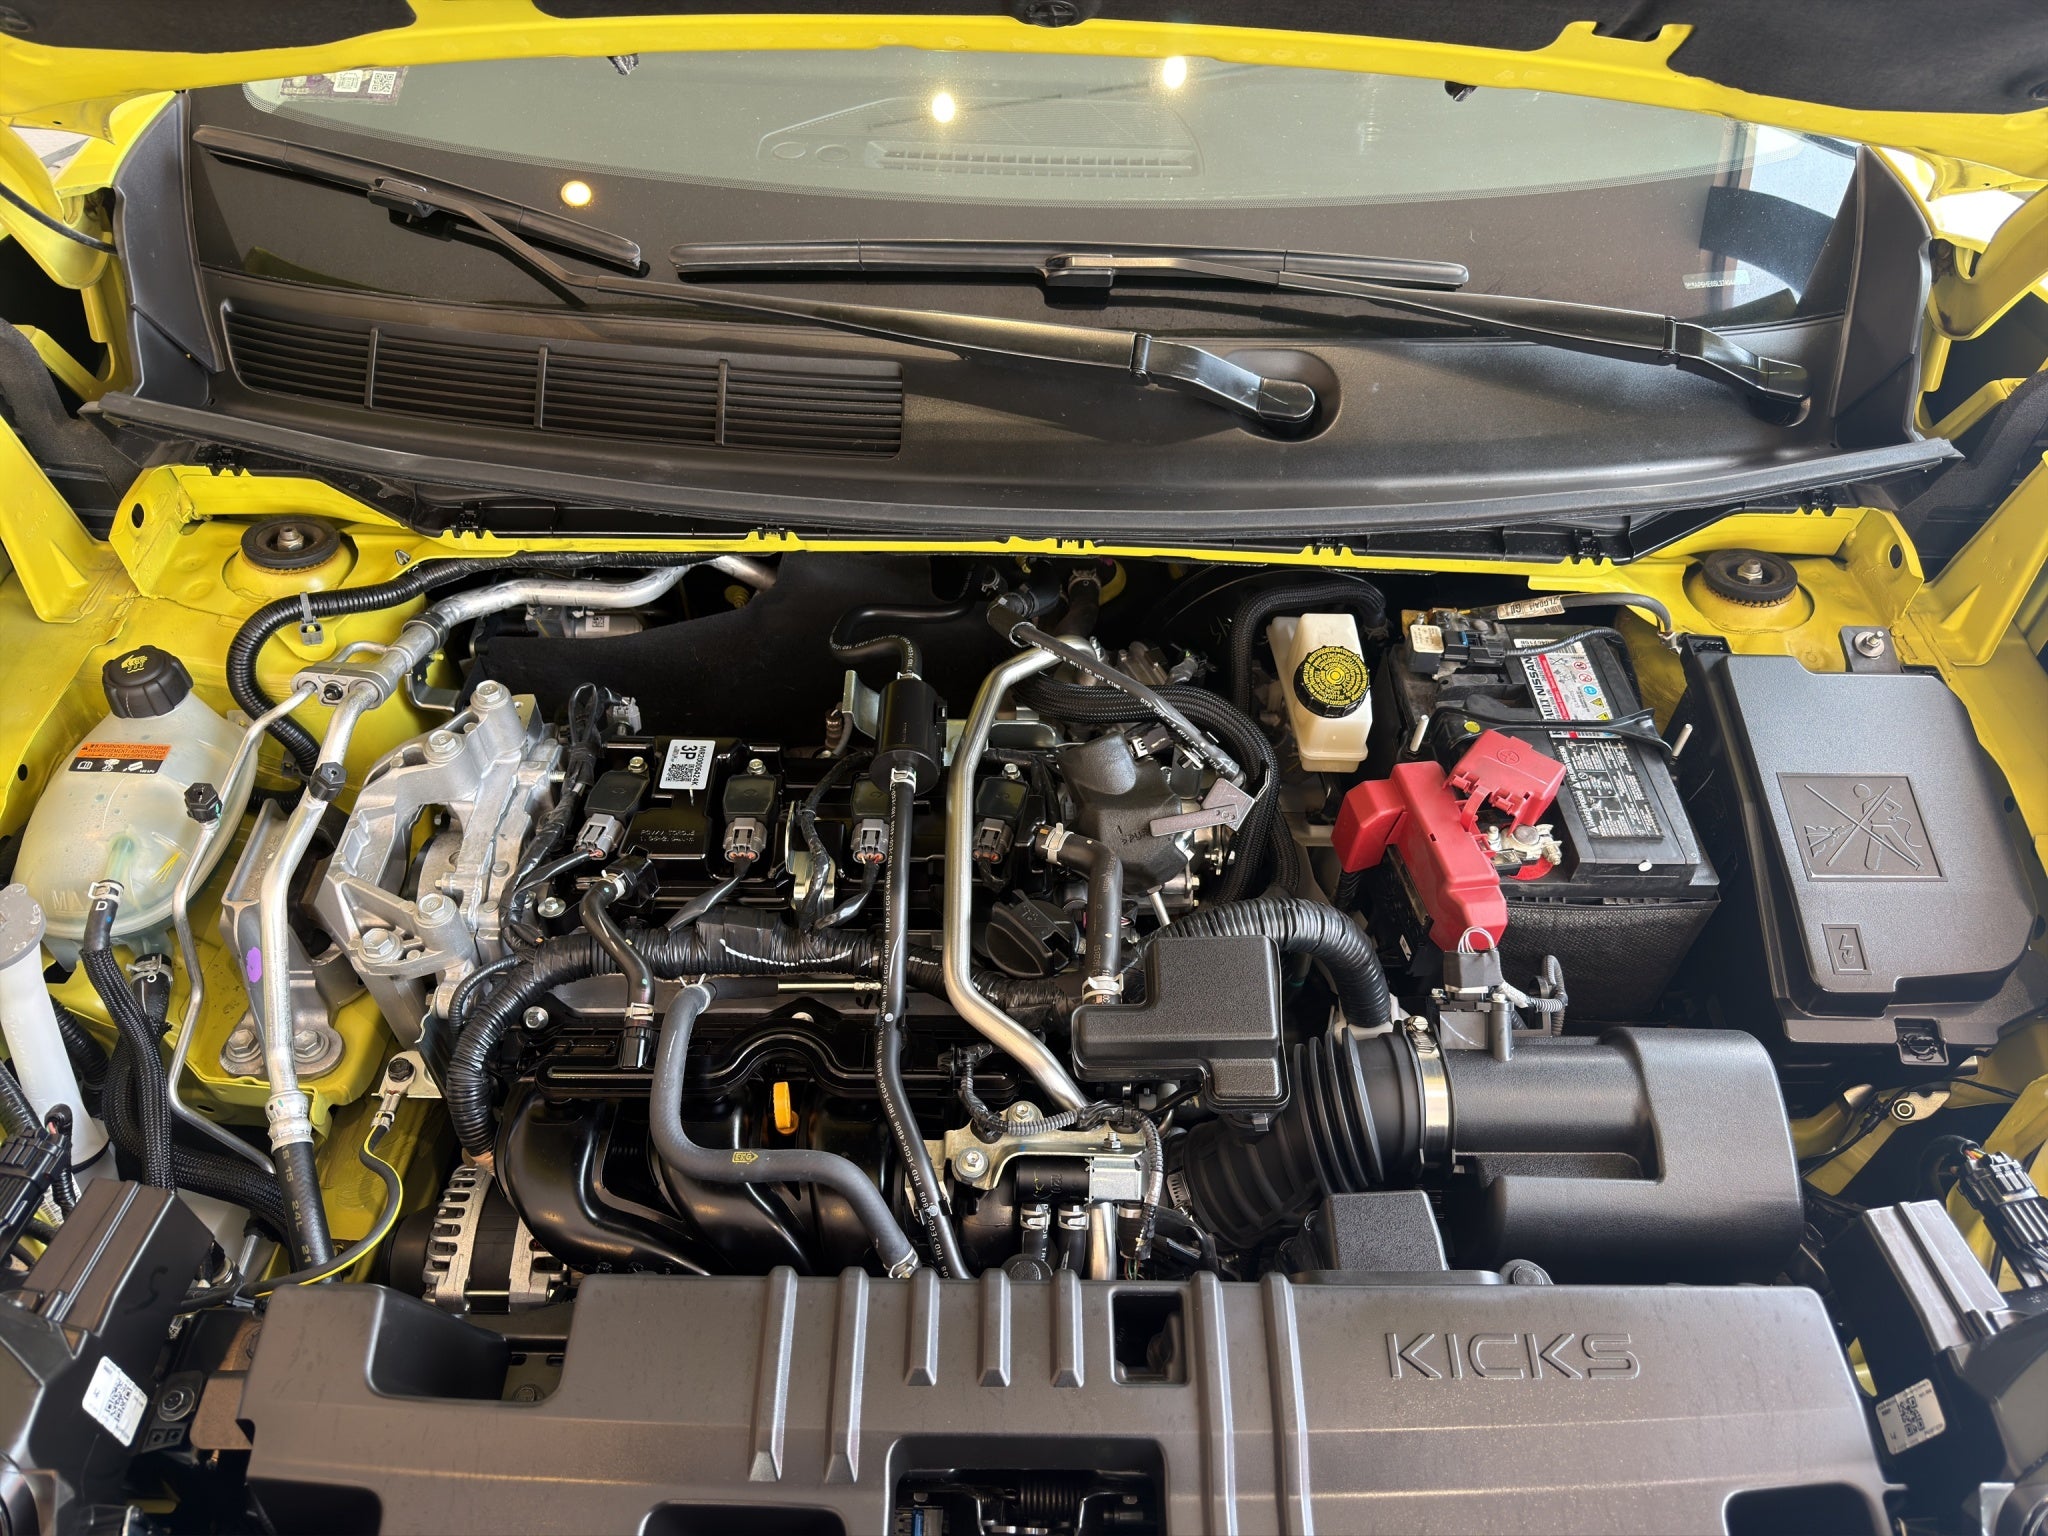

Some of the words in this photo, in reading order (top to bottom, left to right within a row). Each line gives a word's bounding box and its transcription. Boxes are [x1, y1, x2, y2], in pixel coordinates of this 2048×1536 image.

[1523, 656, 1546, 696] NISSAN
[680, 745, 698, 760] 3P
[95, 901, 108, 911] D
[1384, 1332, 1641, 1380] KICKS
